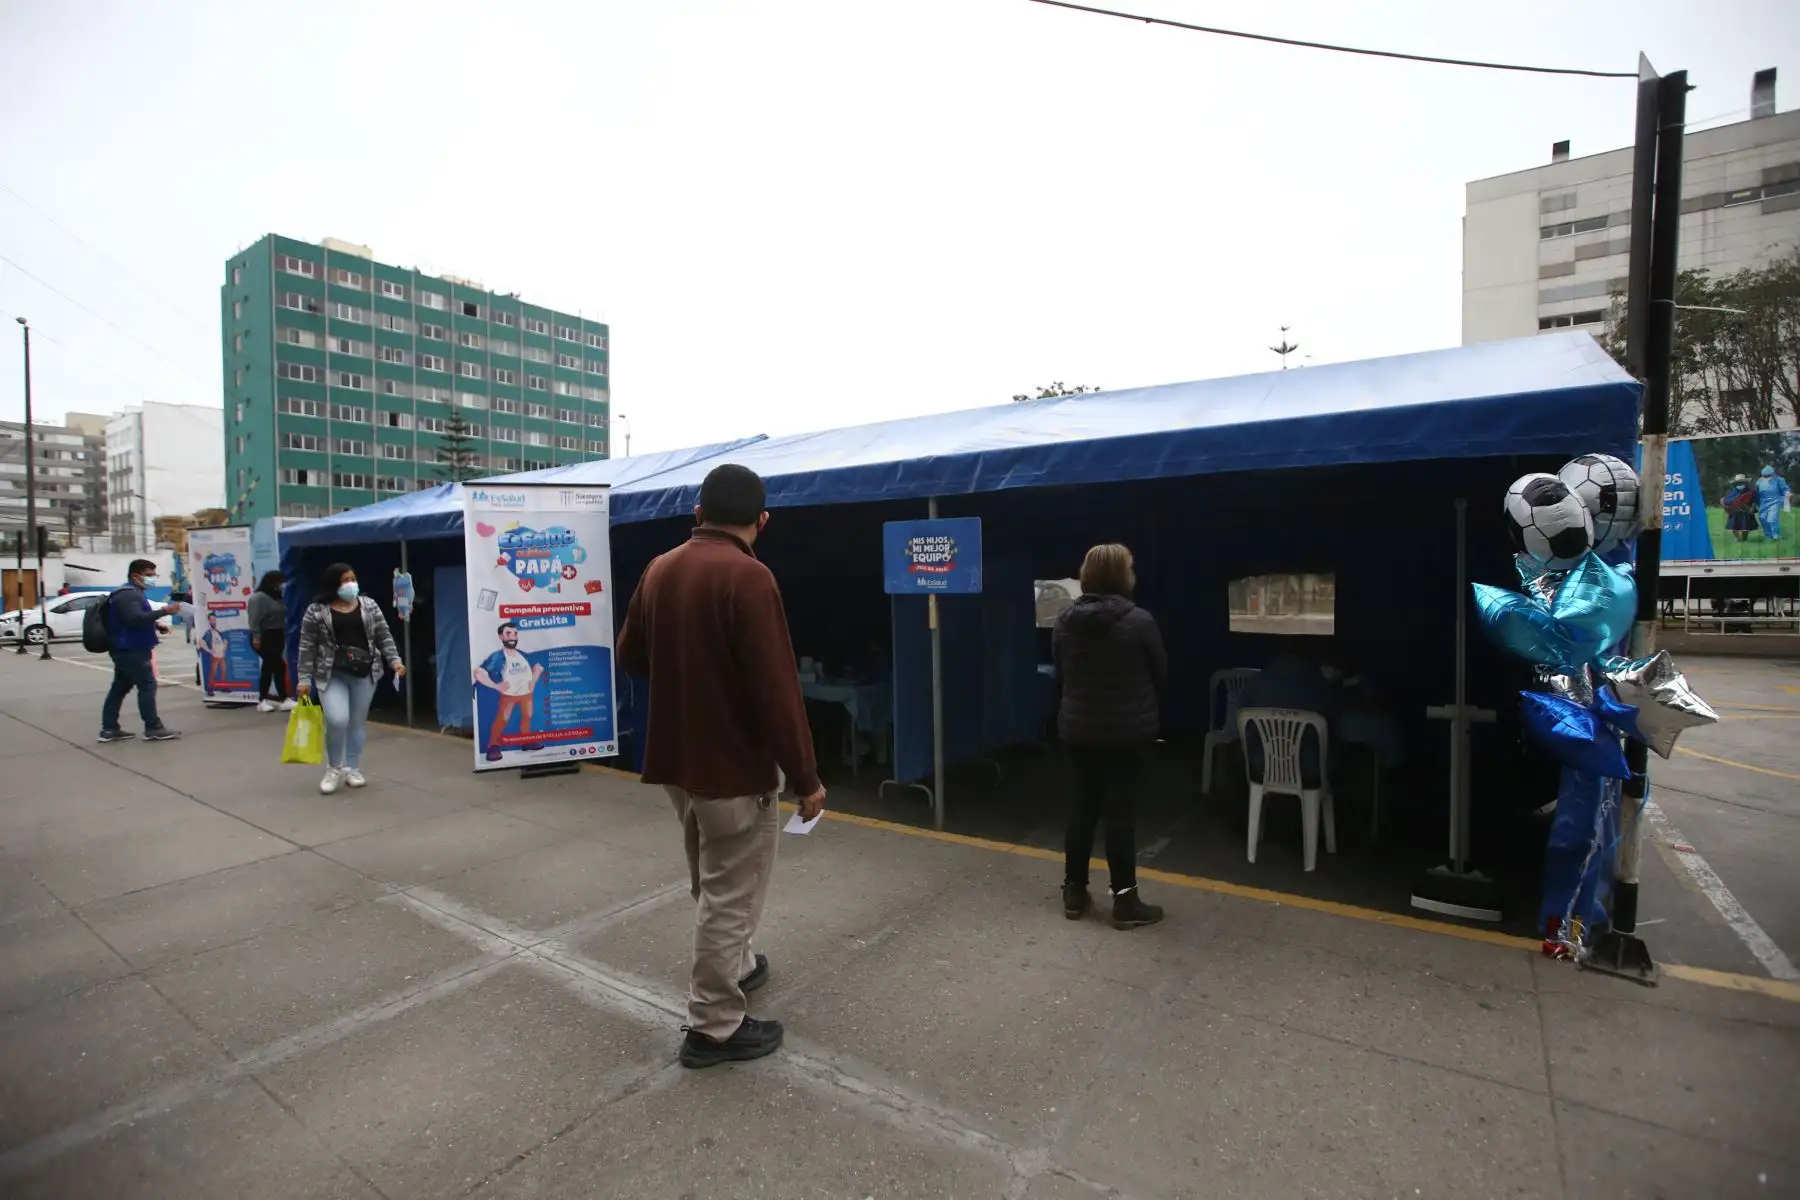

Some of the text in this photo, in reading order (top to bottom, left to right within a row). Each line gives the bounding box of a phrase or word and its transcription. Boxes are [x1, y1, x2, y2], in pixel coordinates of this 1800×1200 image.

[1662, 502, 1690, 516] erú
[912, 537, 925, 545] MIS
[912, 544, 950, 553] MI MEJOR
[913, 552, 951, 563] EQUIPO
[515, 555, 563, 575] PAPÁ
[503, 604, 584, 615] Campaña preventiva
[519, 615, 568, 628] Gratuita
